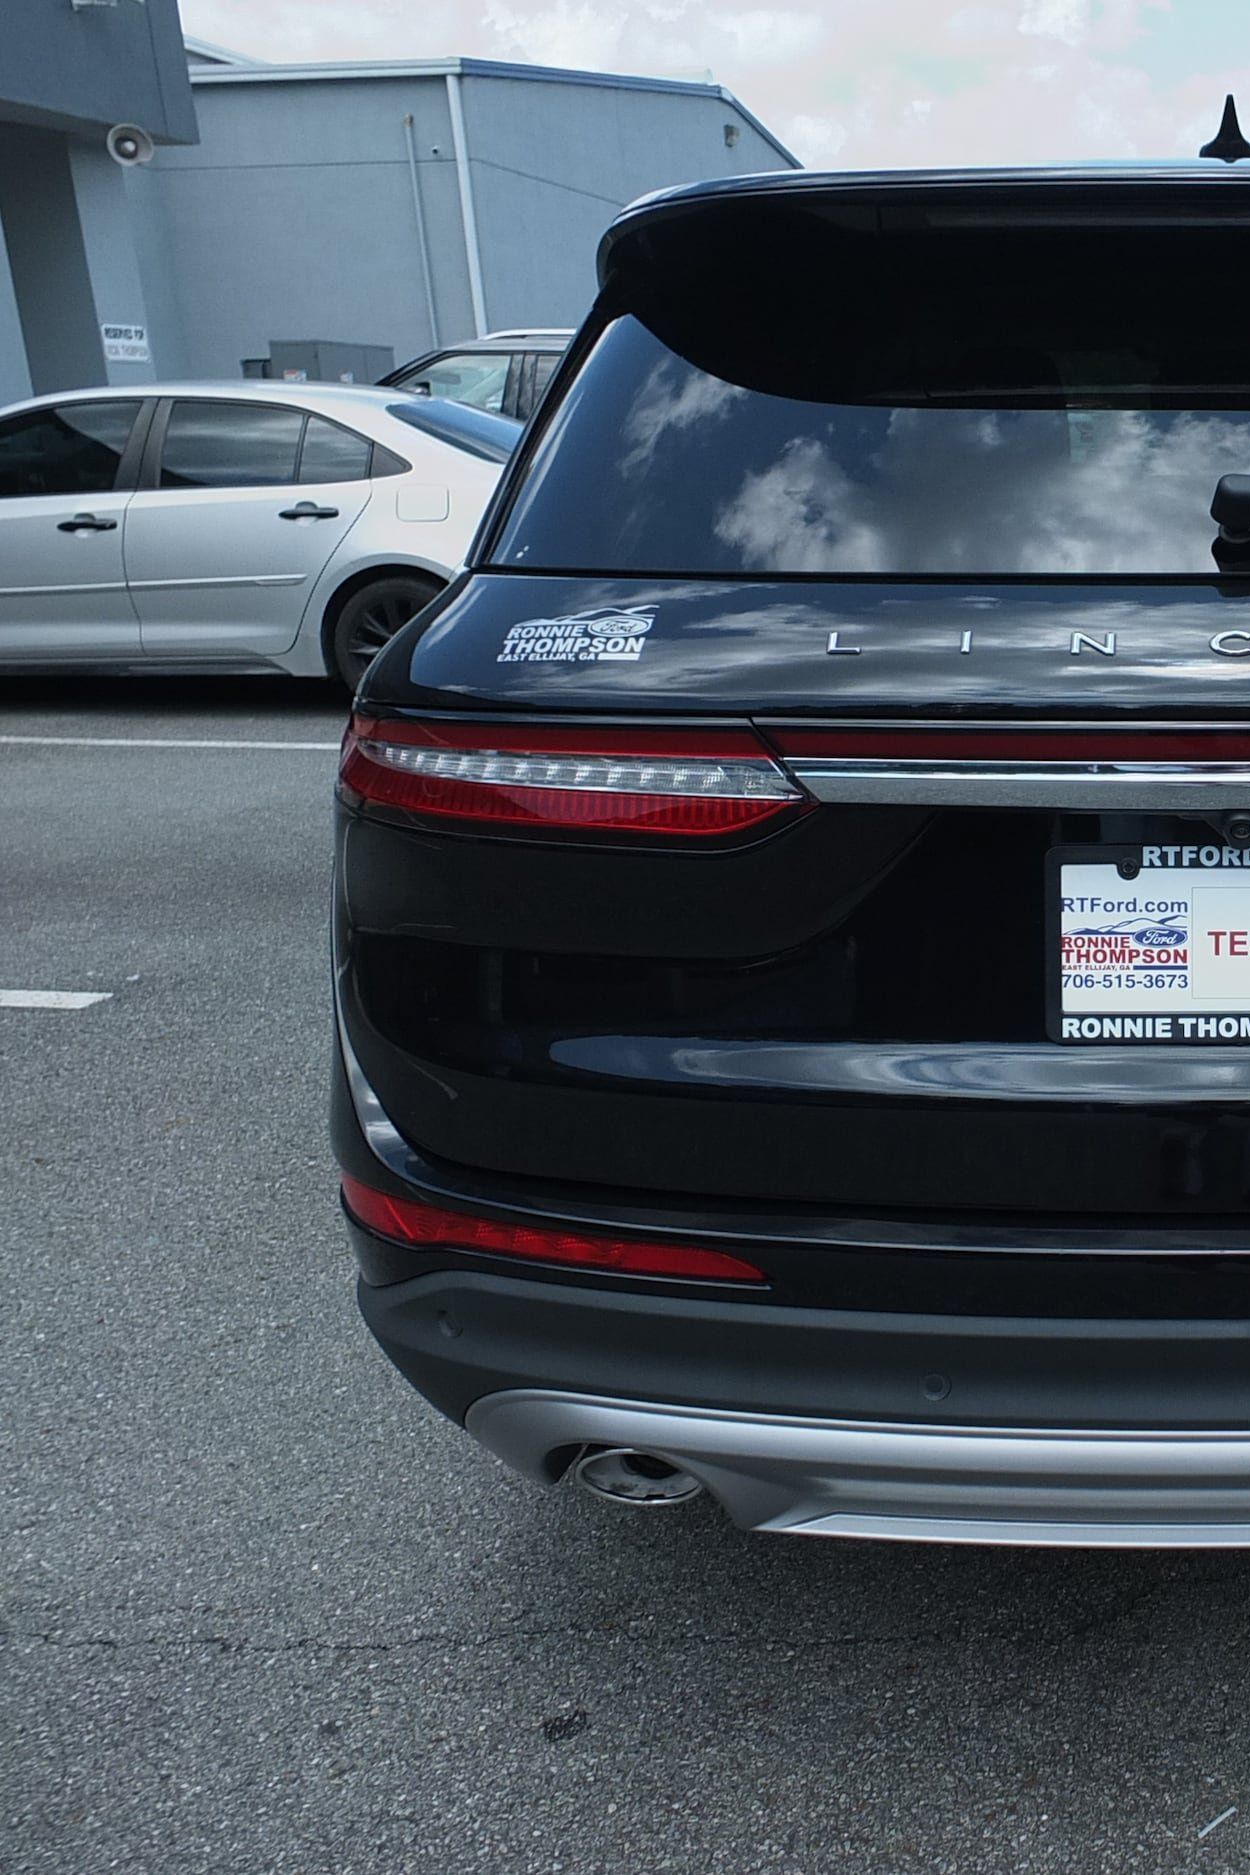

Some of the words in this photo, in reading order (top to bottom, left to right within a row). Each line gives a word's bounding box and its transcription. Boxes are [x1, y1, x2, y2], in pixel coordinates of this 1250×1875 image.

[507, 625, 586, 639] RONNIE
[502, 637, 645, 654] THOMPSON
[497, 653, 526, 662] EAST
[528, 652, 576, 662] ELLIJAY,
[579, 652, 596, 661] GA
[1060, 897, 1188, 913] RTFord.com
[1061, 936, 1130, 948] RONNIE
[1061, 949, 1188, 963] THOMPSON
[1062, 974, 1188, 989] 706-515-3673
[1062, 1018, 1172, 1038] RONNIE
